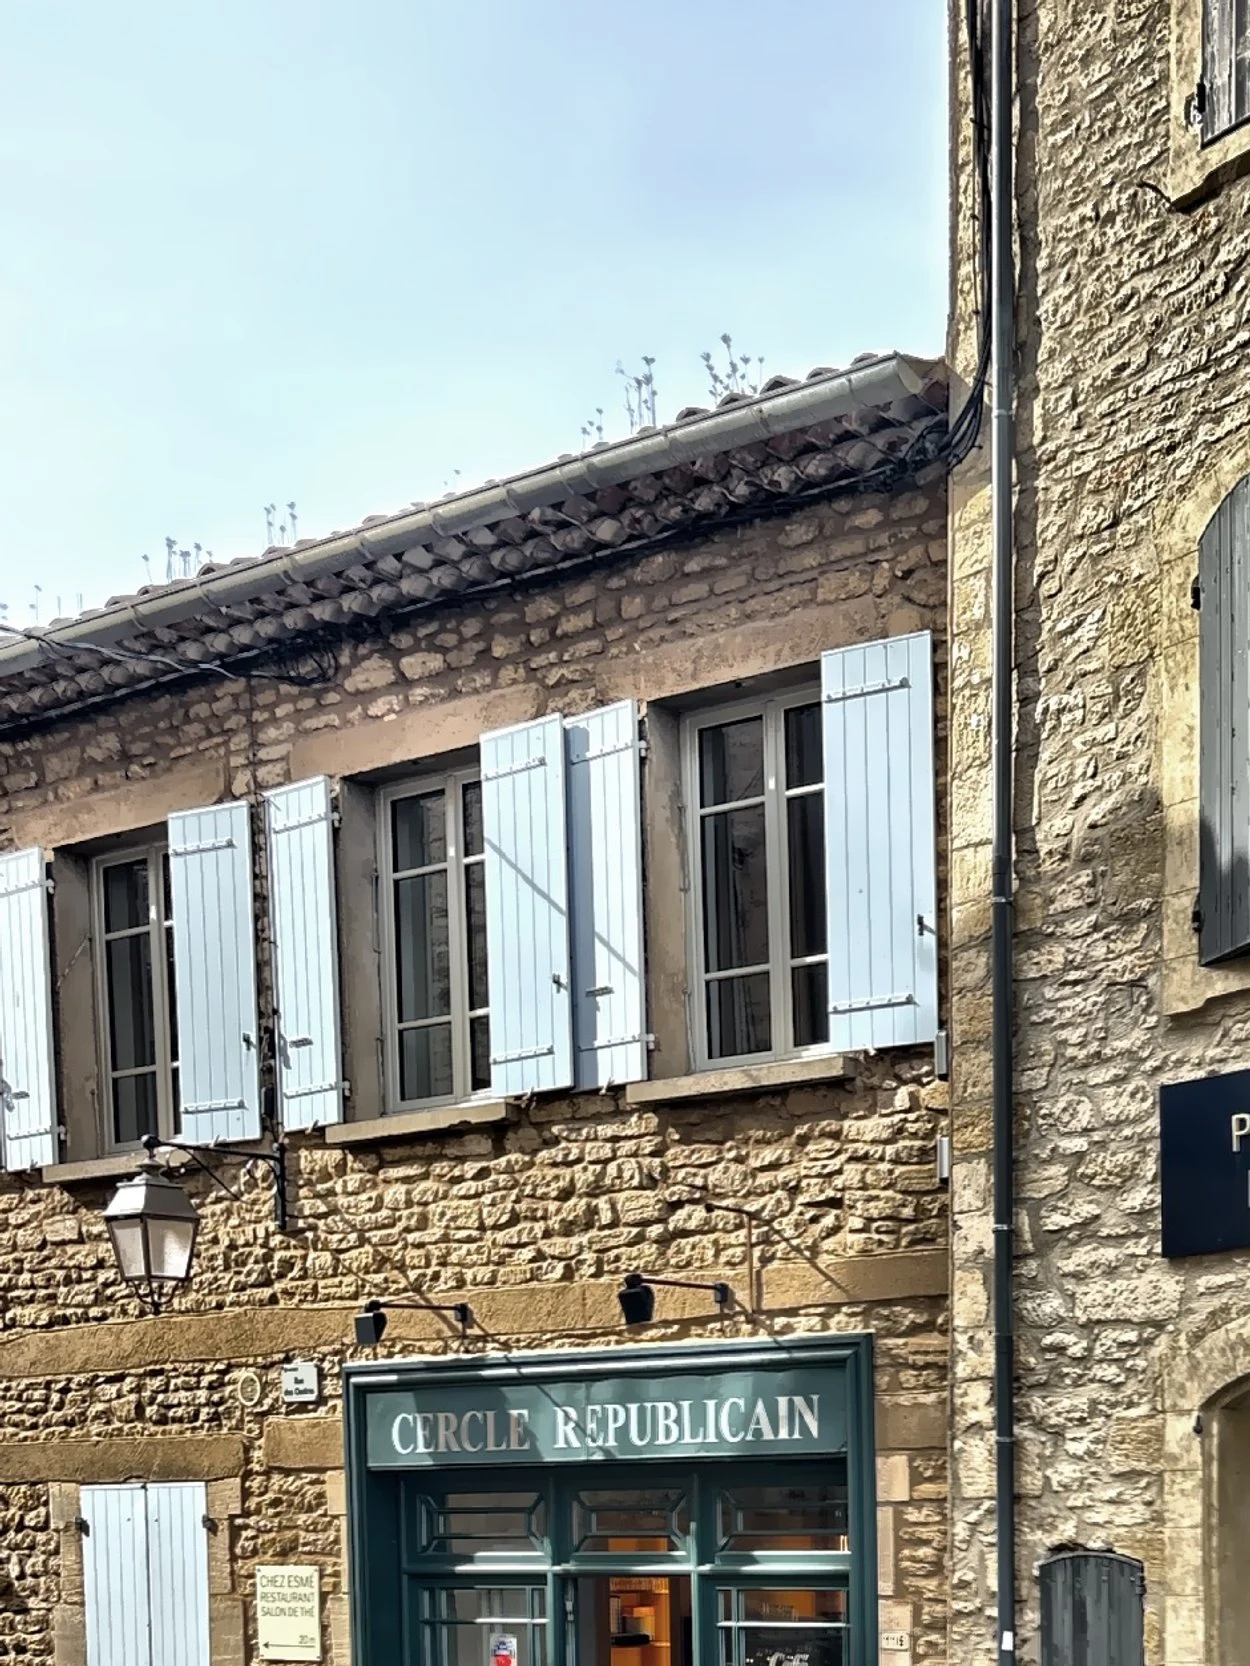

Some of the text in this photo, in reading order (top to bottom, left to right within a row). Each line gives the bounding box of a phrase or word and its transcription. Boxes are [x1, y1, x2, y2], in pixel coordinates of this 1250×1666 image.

[391, 1394, 820, 1454] CERCLE REPUBLICAIN
[260, 1574, 285, 1588] CHEZ
[260, 1591, 315, 1603] RESTAURANT
[261, 1606, 287, 1617] SALON
[288, 1606, 299, 1617] DE
